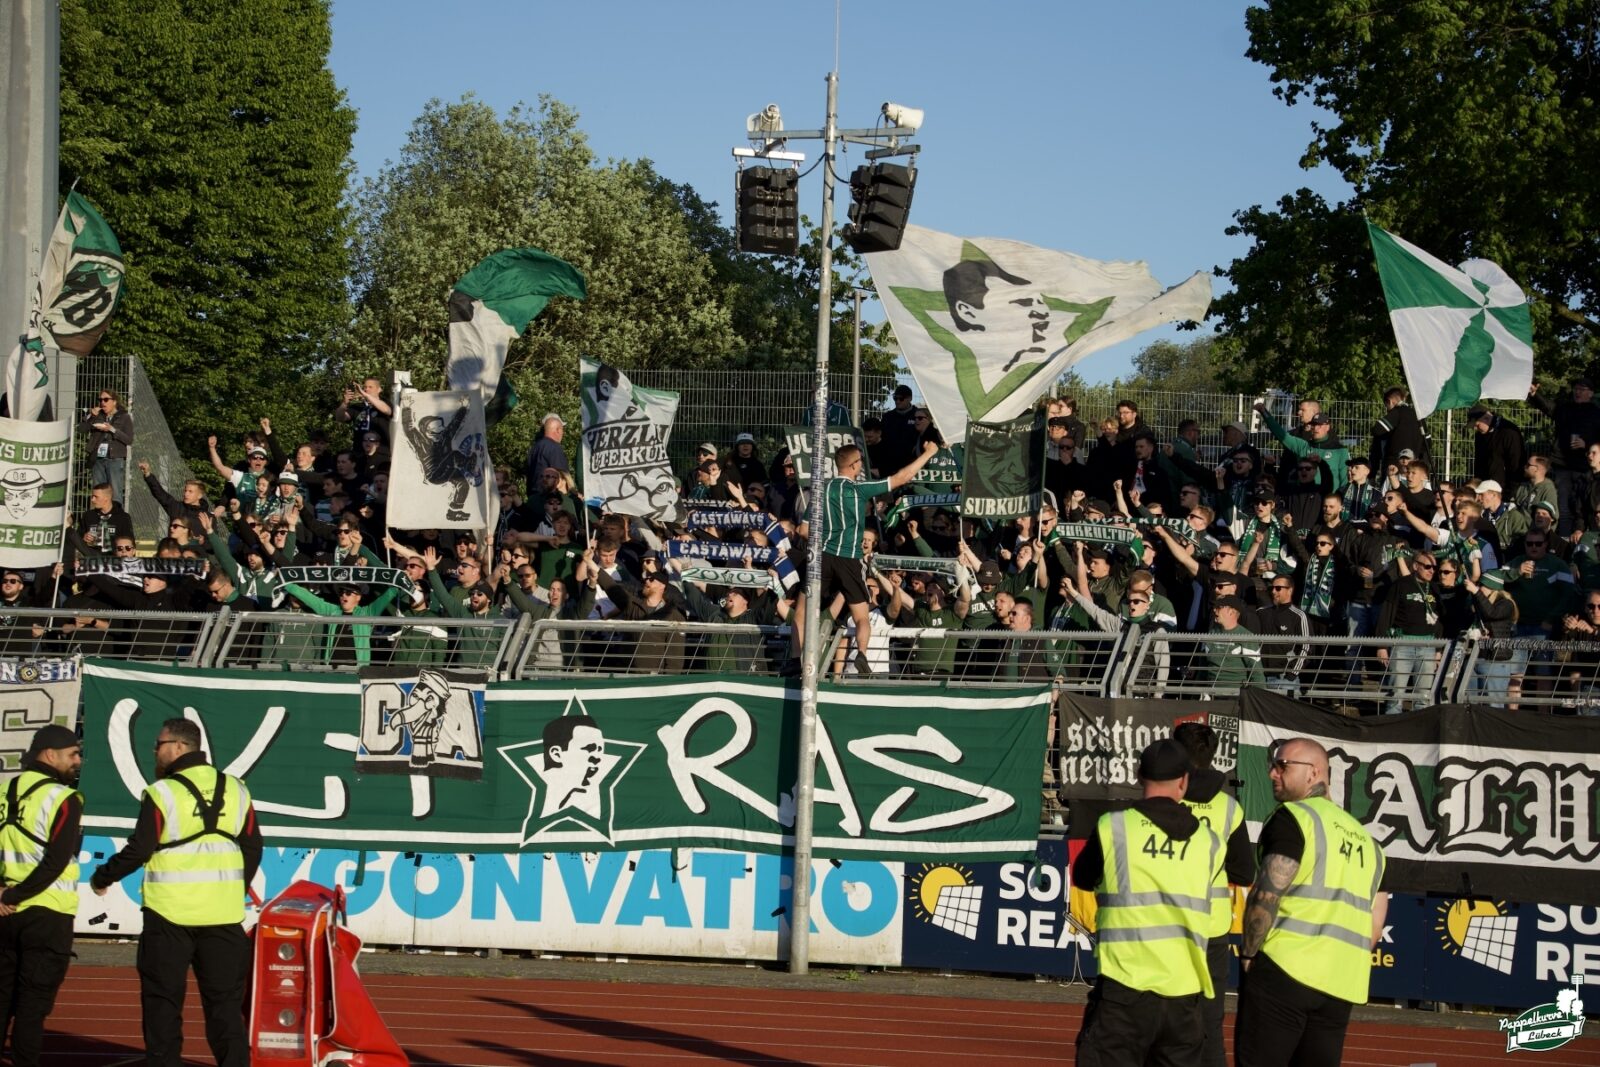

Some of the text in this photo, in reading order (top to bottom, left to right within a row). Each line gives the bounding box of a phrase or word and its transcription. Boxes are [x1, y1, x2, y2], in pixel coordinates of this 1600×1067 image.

[22, 529, 61, 546] 2002
[1142, 833, 1191, 861] 447
[1339, 838, 1364, 869] 471
